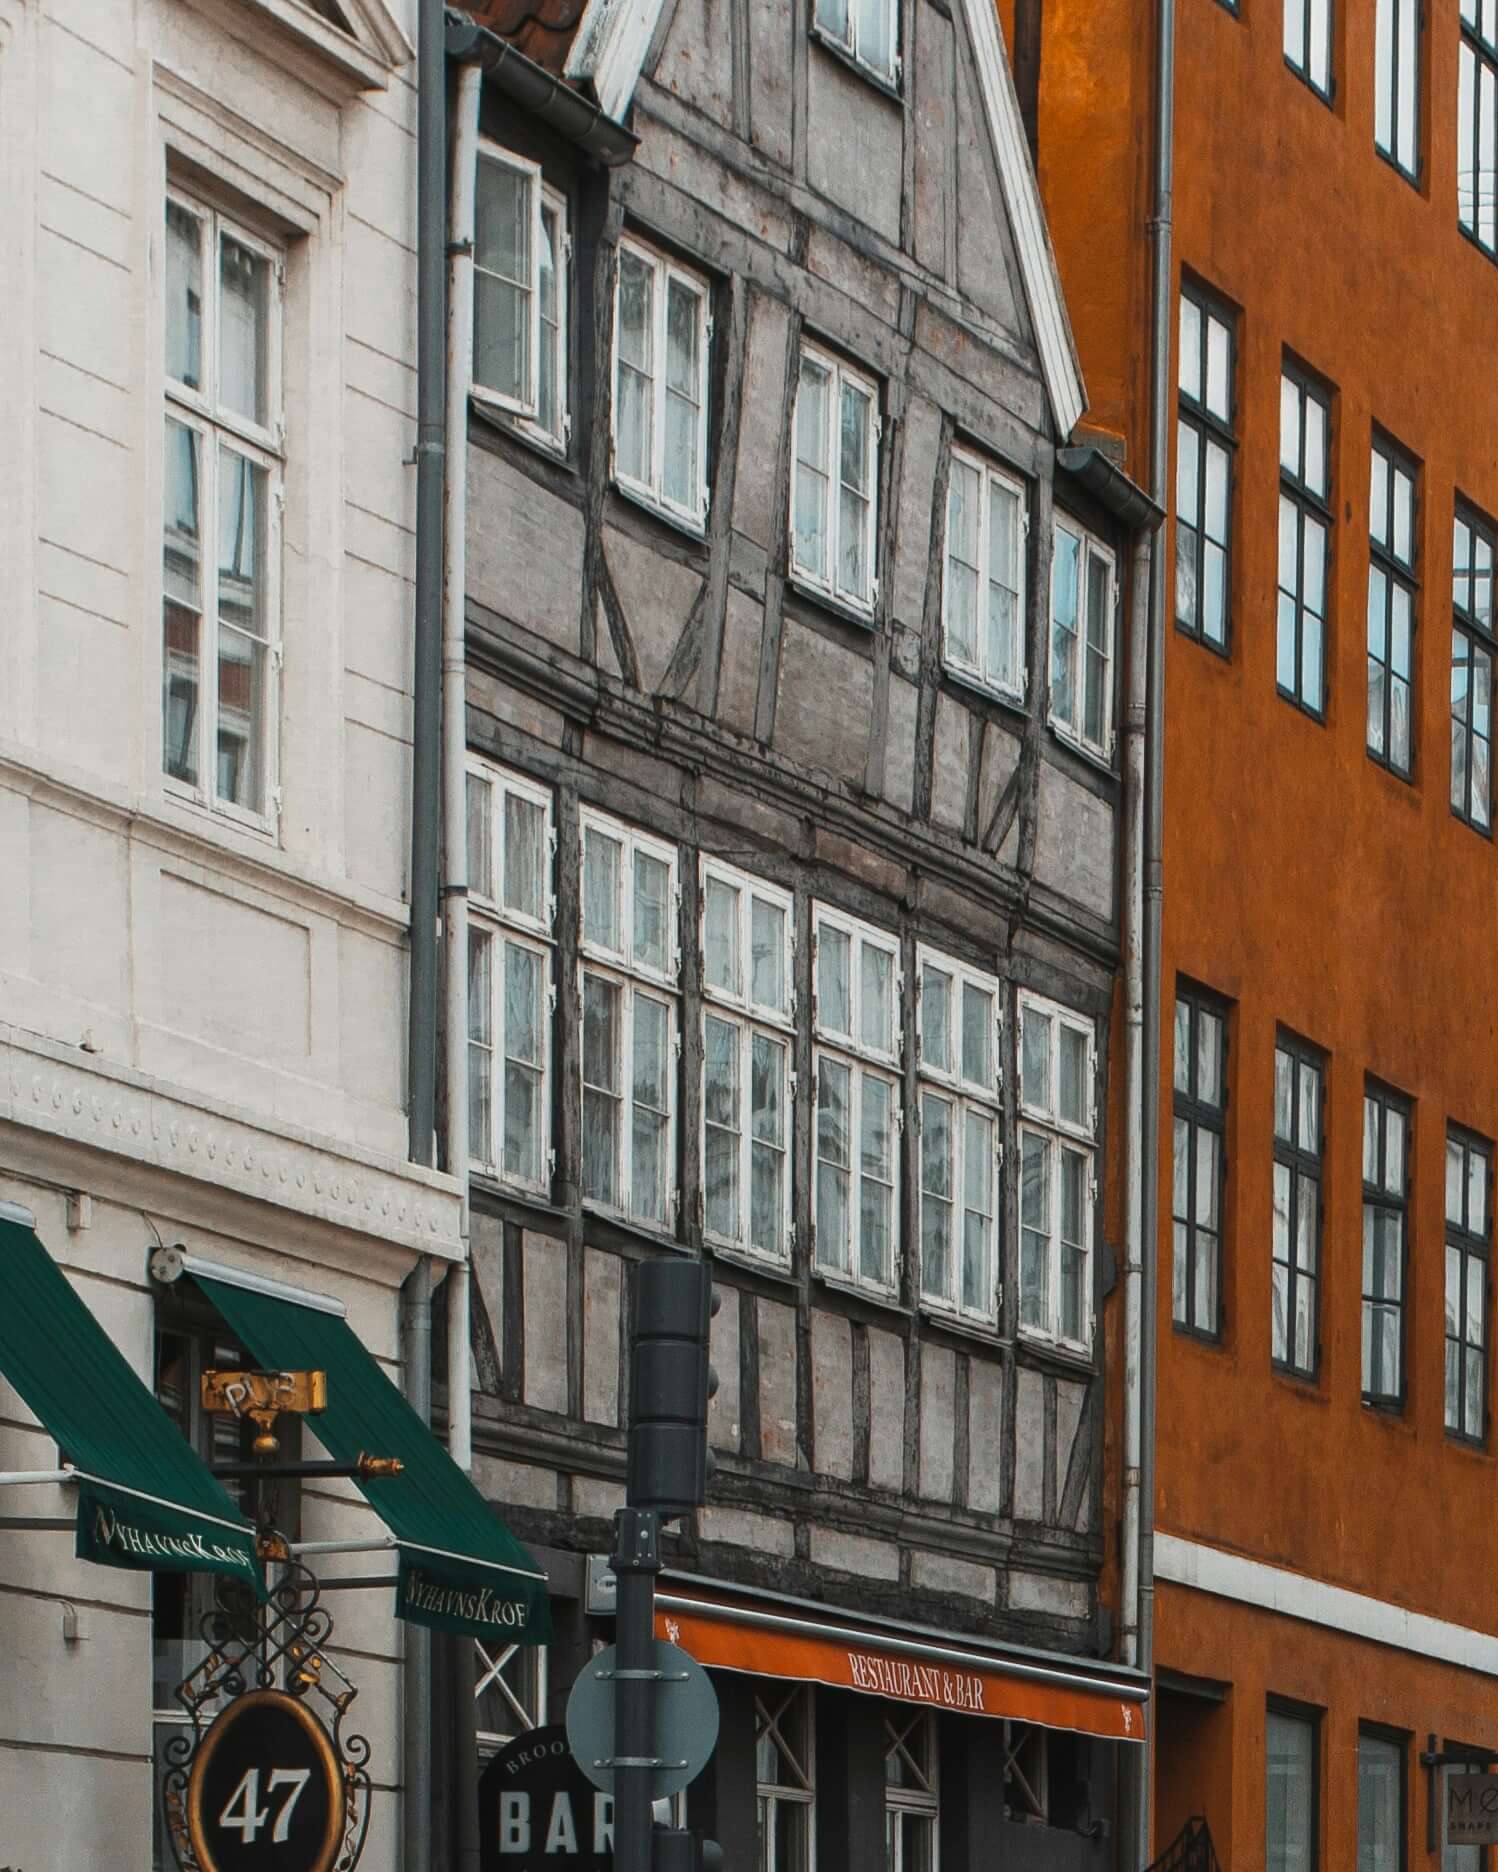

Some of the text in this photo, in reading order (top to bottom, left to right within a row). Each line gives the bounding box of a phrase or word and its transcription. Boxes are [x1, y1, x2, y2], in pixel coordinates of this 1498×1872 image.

[225, 1372, 295, 1418] PUB
[848, 1653, 985, 1711] RESTAURANT & BAR
[219, 1768, 311, 1844] 47
[499, 1791, 615, 1854] BAR
